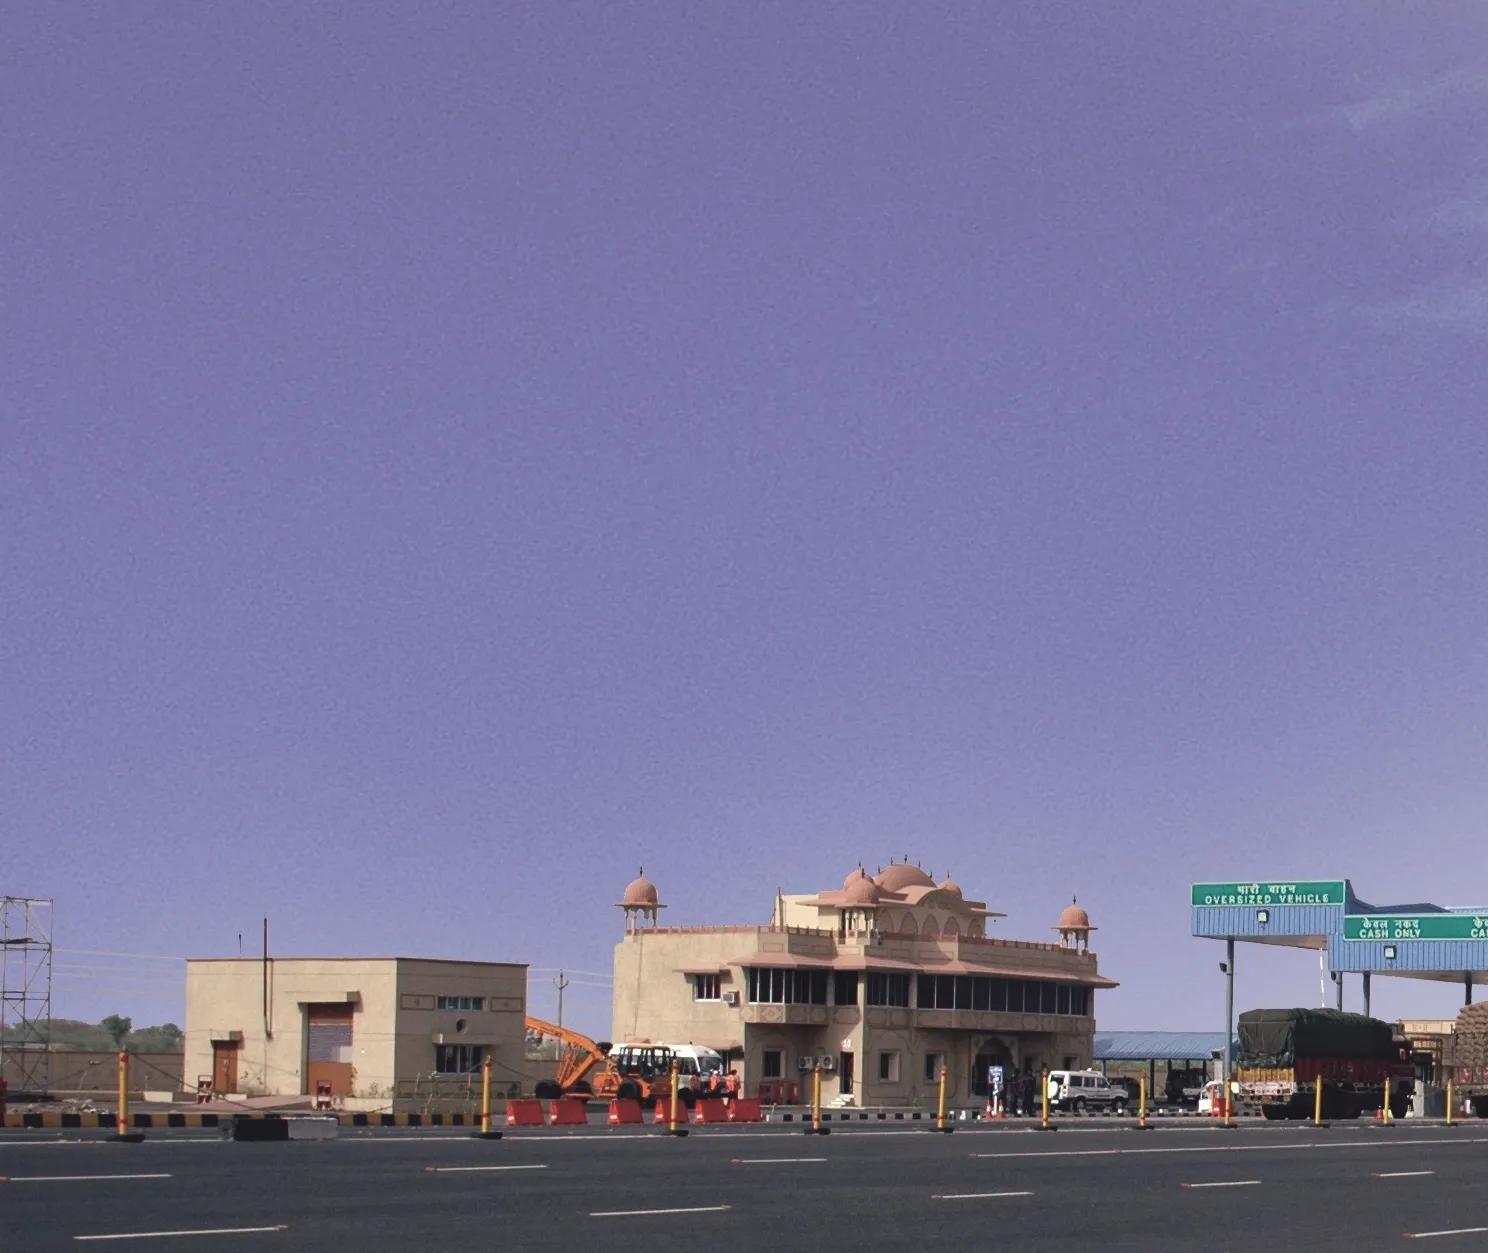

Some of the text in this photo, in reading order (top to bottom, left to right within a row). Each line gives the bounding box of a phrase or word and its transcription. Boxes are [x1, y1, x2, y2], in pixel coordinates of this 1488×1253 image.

[1237, 884, 1296, 894] भारी वाहन
[1205, 894, 1329, 905] OVERSIZED VEHICLE
[1361, 917, 1419, 928] केवल नकद
[1359, 928, 1421, 938] CASH ONLY
